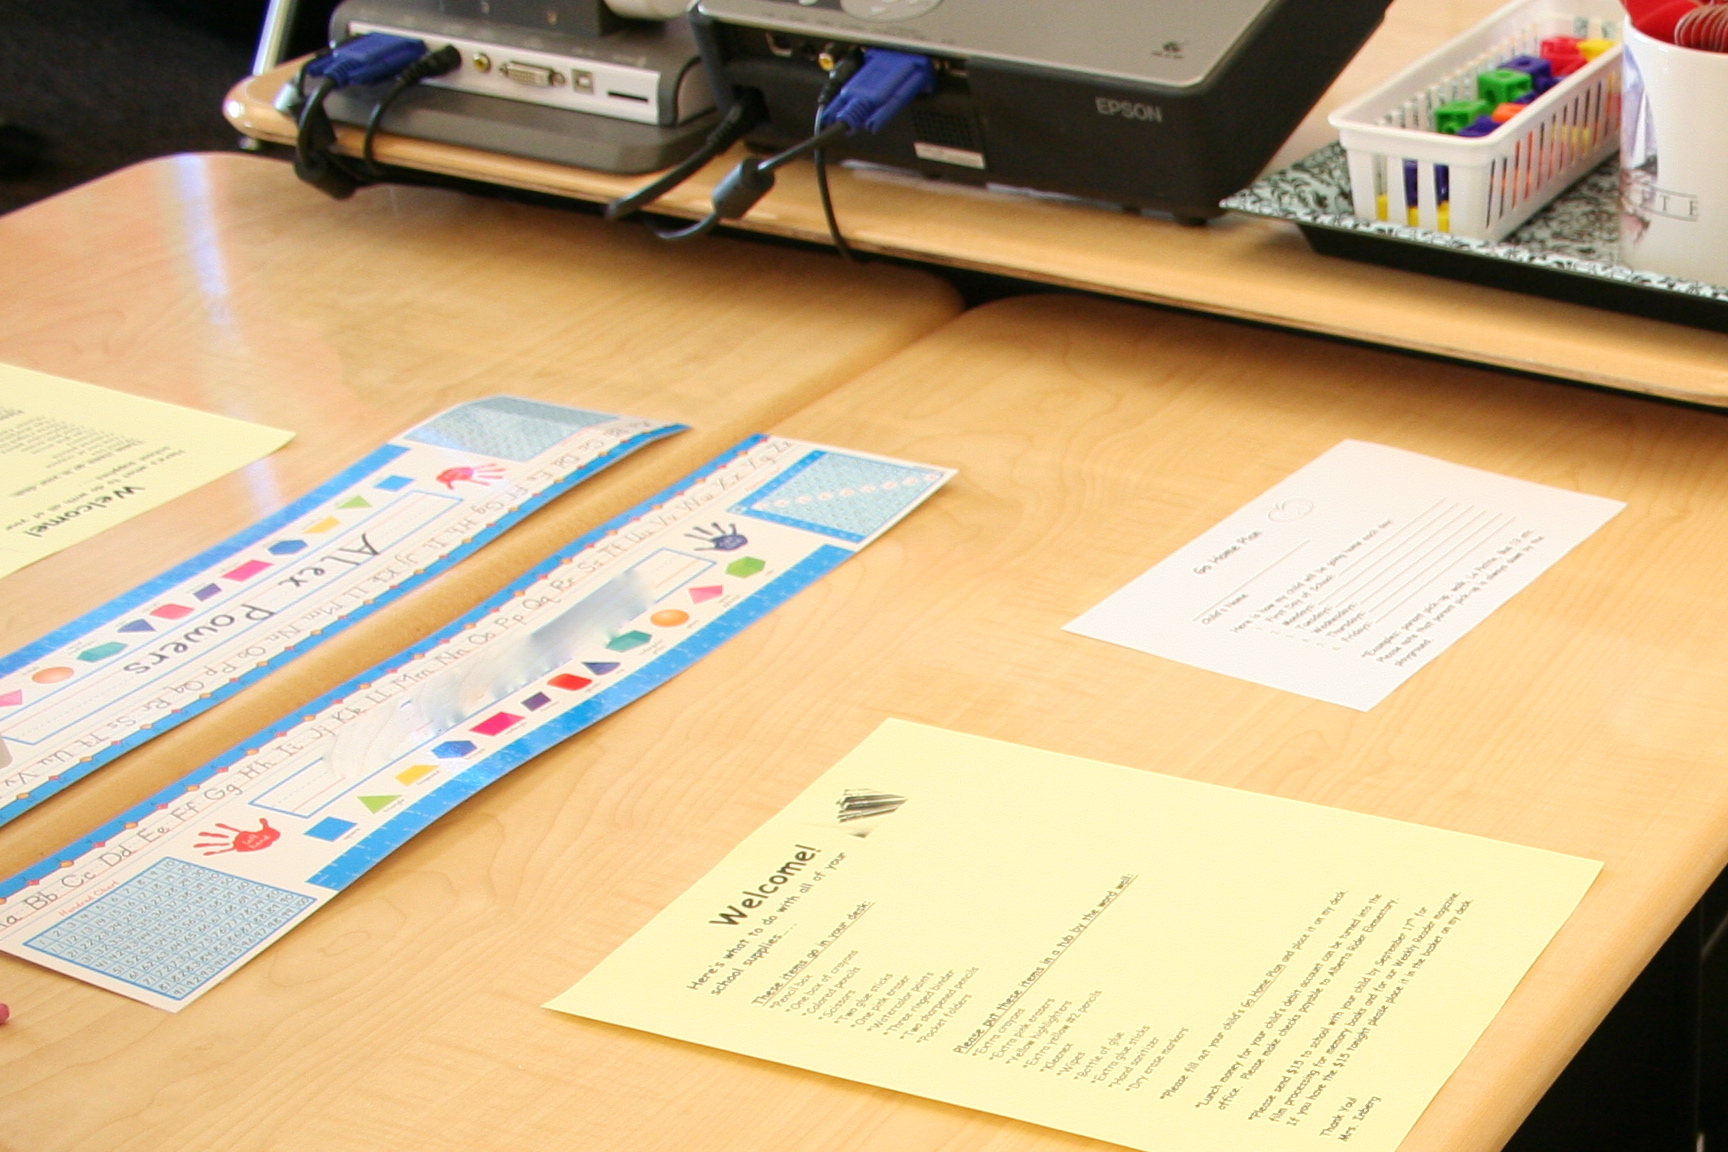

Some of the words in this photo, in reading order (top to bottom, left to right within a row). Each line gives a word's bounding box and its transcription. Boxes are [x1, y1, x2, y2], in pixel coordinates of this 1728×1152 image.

[1095, 97, 1163, 123] EPSON
[23, 484, 146, 538] Welcome!
[278, 532, 381, 590] Alex
[123, 602, 277, 676] Powers
[685, 960, 726, 990] Here's
[721, 938, 751, 959] what
[746, 926, 764, 936] to
[759, 914, 779, 925] do
[774, 894, 801, 913] with
[797, 882, 815, 893] all
[810, 870, 827, 881] of
[823, 851, 849, 870] your
[707, 843, 823, 926] Welcome!
[708, 967, 745, 995] school
[750, 981, 784, 1004] These
[780, 959, 808, 980] items
[805, 948, 822, 958] go
[815, 939, 832, 947] in
[826, 920, 852, 938] your
[845, 900, 874, 920] desk:
[952, 1027, 985, 1053] Please
[981, 1012, 1001, 1027] put
[994, 989, 1023, 1010] these
[1017, 966, 1045, 987] items
[1039, 956, 1055, 964] in
[1055, 934, 1077, 948] tub
[1068, 922, 1088, 933] by
[1080, 908, 1102, 922] the
[1095, 890, 1119, 908] word
[1113, 872, 1137, 889] wall:
